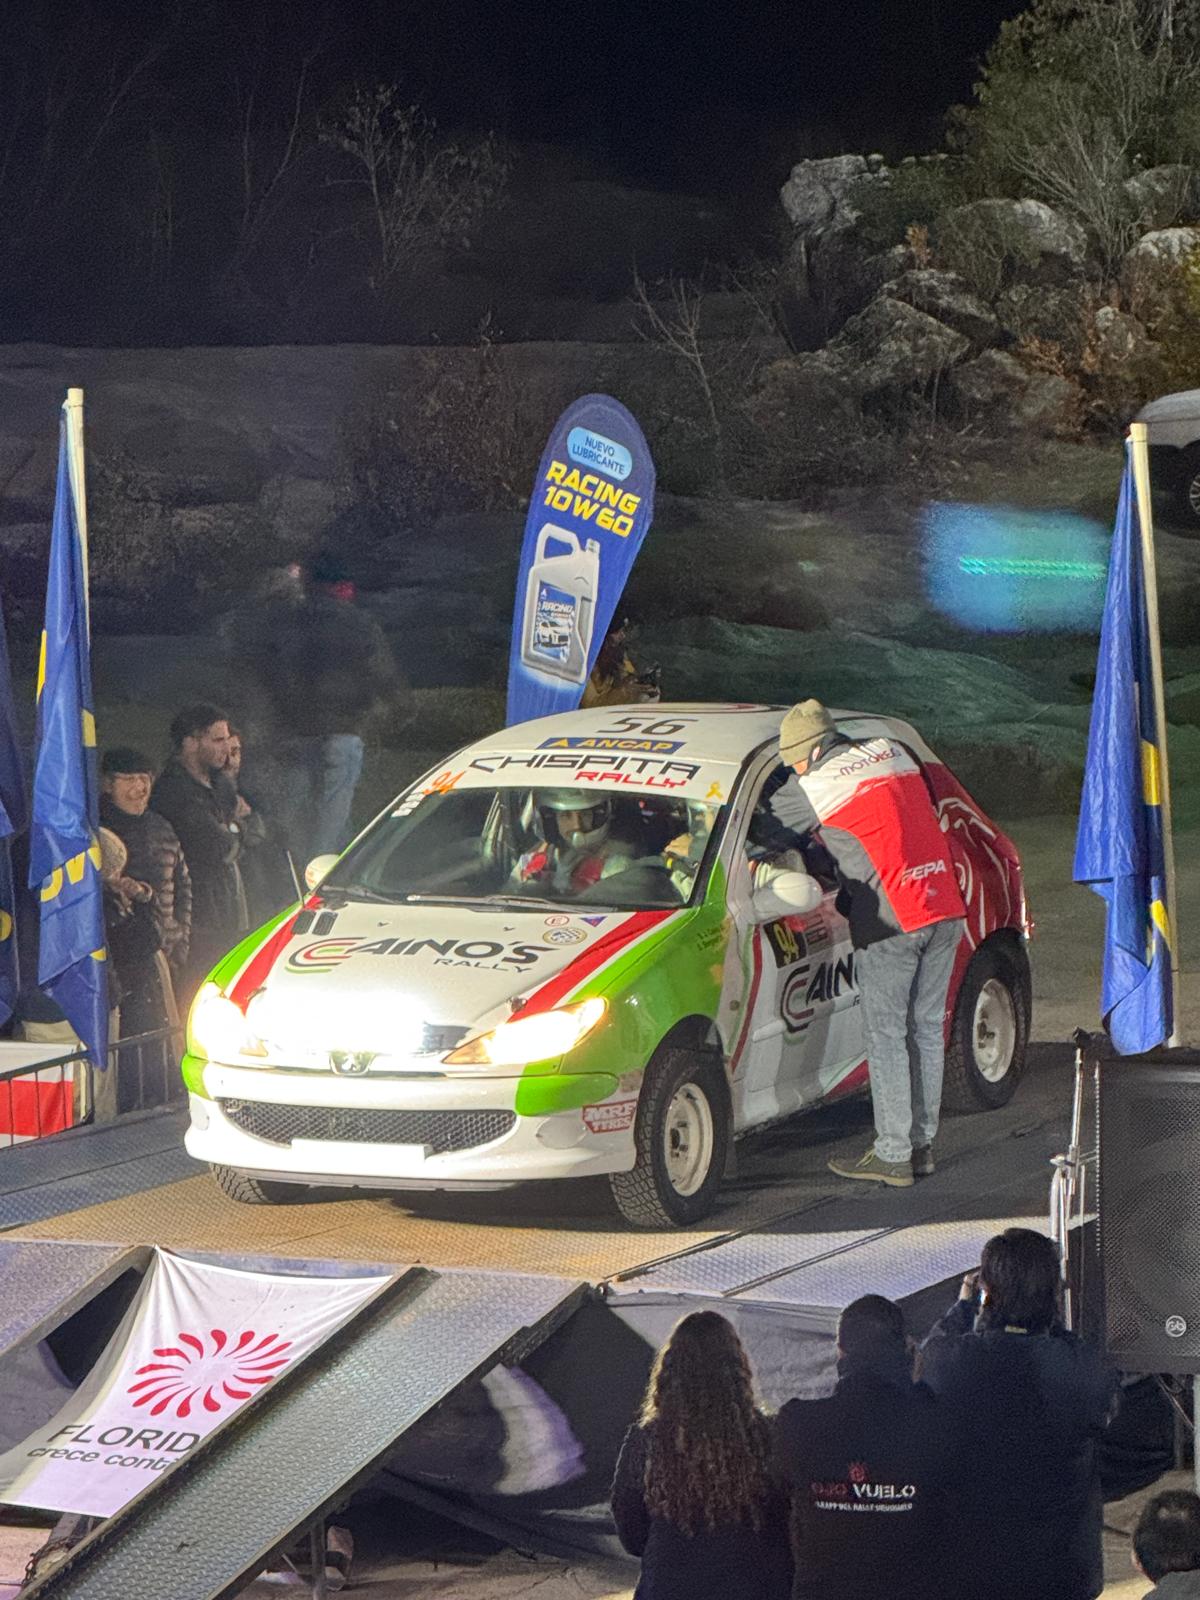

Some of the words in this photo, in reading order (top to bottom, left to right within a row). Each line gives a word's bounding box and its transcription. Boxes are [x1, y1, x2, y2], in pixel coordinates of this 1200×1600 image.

[572, 443, 625, 475] LUBRICANTE
[585, 436, 615, 456] NUEVO
[545, 460, 641, 516] RACING
[543, 485, 634, 538] 10W60
[595, 716, 699, 735] 56
[578, 739, 673, 752] ANCAP
[468, 752, 702, 781] CHISPITA
[423, 770, 466, 796] 94
[573, 772, 687, 788] RALLY
[900, 859, 947, 887] FEPA
[284, 936, 559, 974] CAINO'S
[433, 957, 536, 974] RALLY
[780, 952, 859, 1046] CAIN
[26, 1447, 101, 1463] crece
[853, 1484, 915, 1498] VUELO
